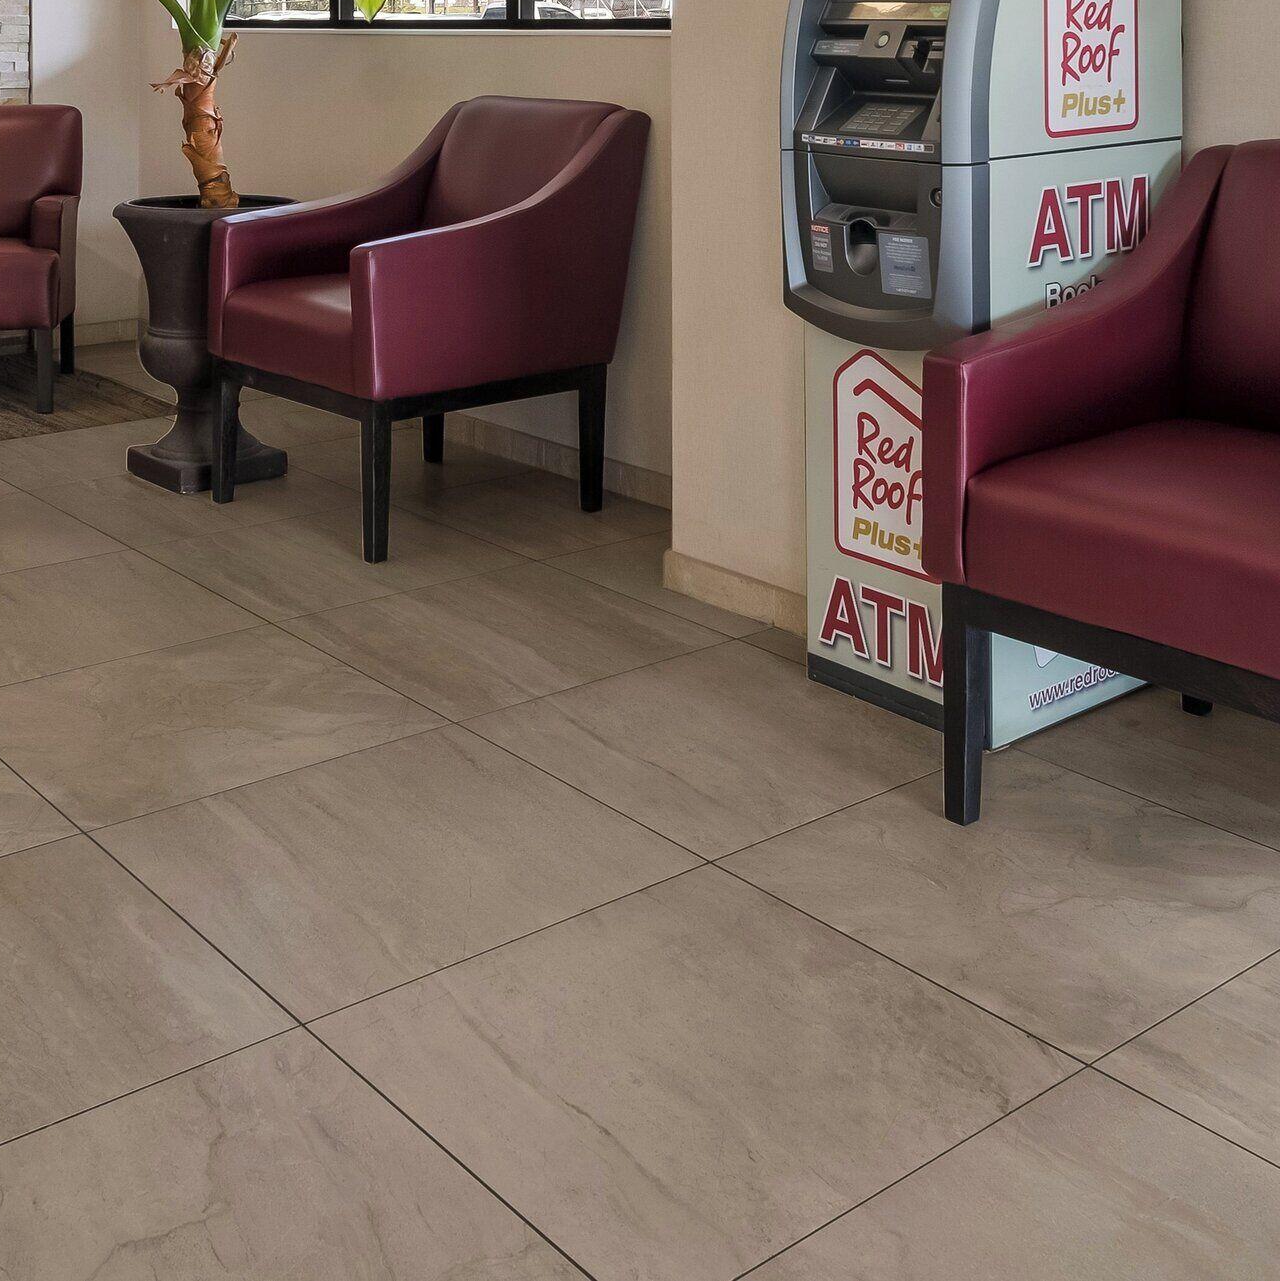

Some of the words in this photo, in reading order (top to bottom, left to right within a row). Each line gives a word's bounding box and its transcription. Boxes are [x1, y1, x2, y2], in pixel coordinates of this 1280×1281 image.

[1060, 24, 1126, 87] Roof
[1061, 89, 1126, 118] Plus+
[1026, 173, 1150, 269] ATM
[856, 411, 915, 473] Red
[851, 457, 922, 525] Roof
